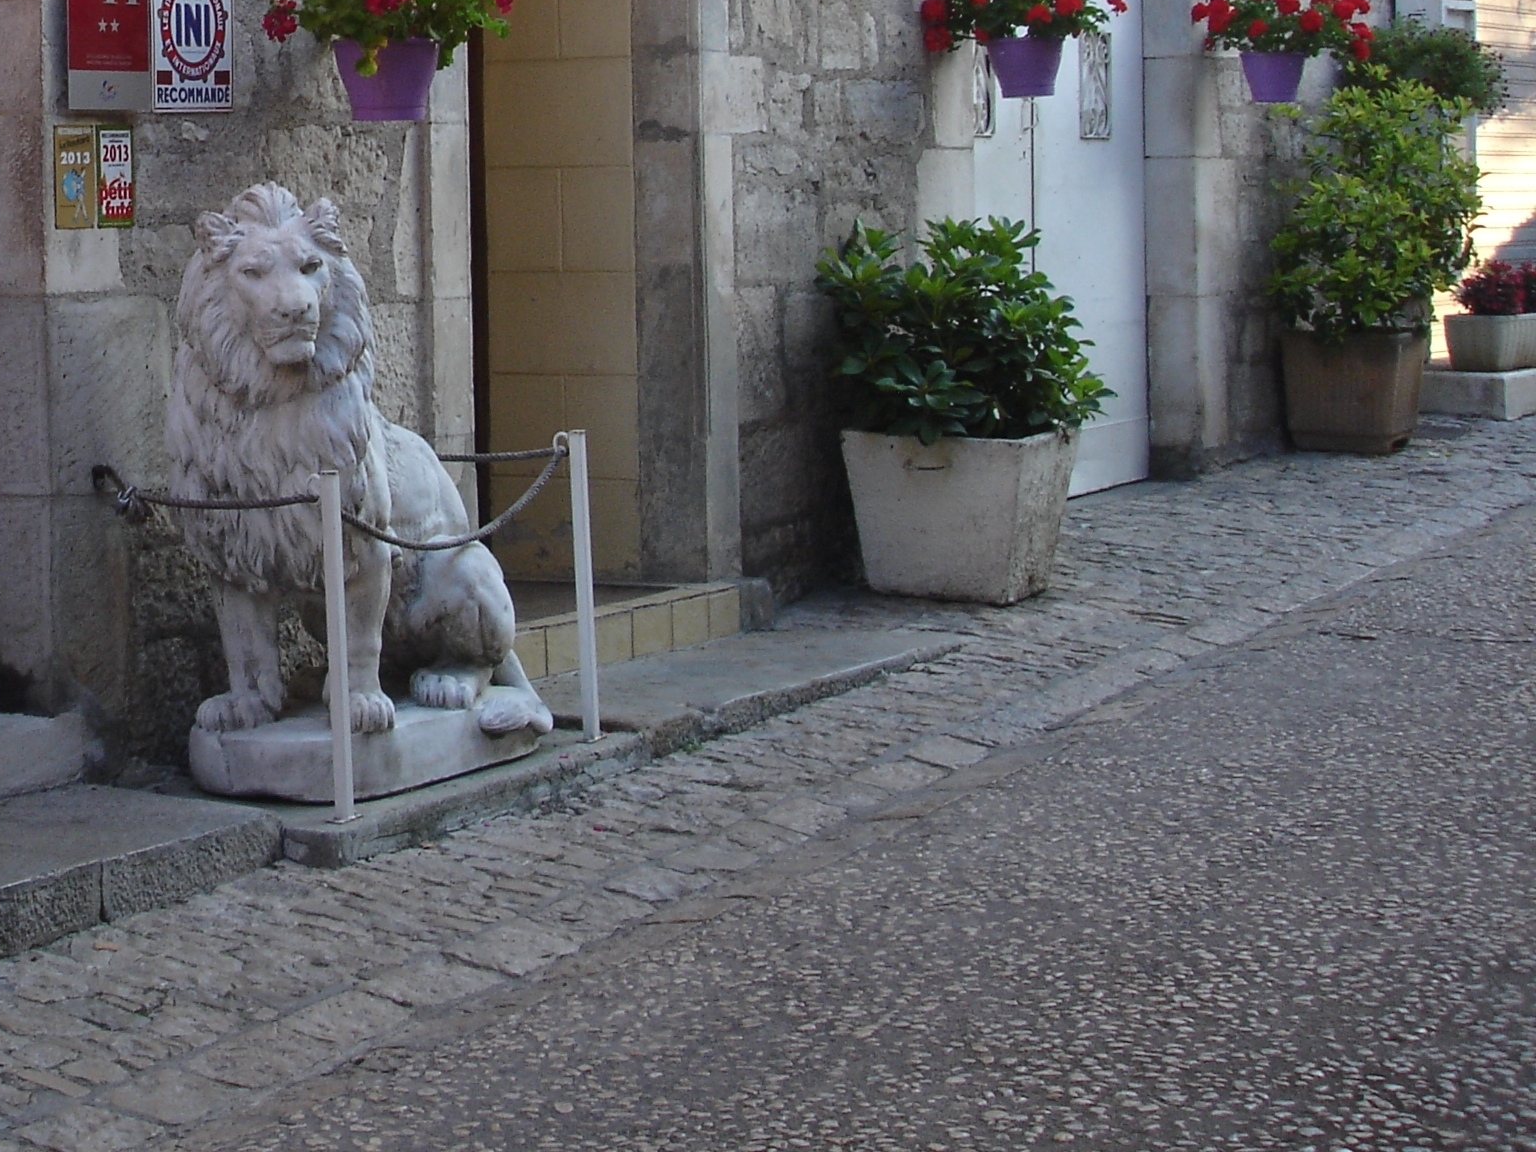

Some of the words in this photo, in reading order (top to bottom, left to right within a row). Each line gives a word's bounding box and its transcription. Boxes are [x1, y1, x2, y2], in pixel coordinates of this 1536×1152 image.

[175, 3, 211, 47] INI
[157, 84, 231, 104] RECOMMANDÉ
[60, 151, 91, 165] 2013
[102, 144, 129, 163] 2013
